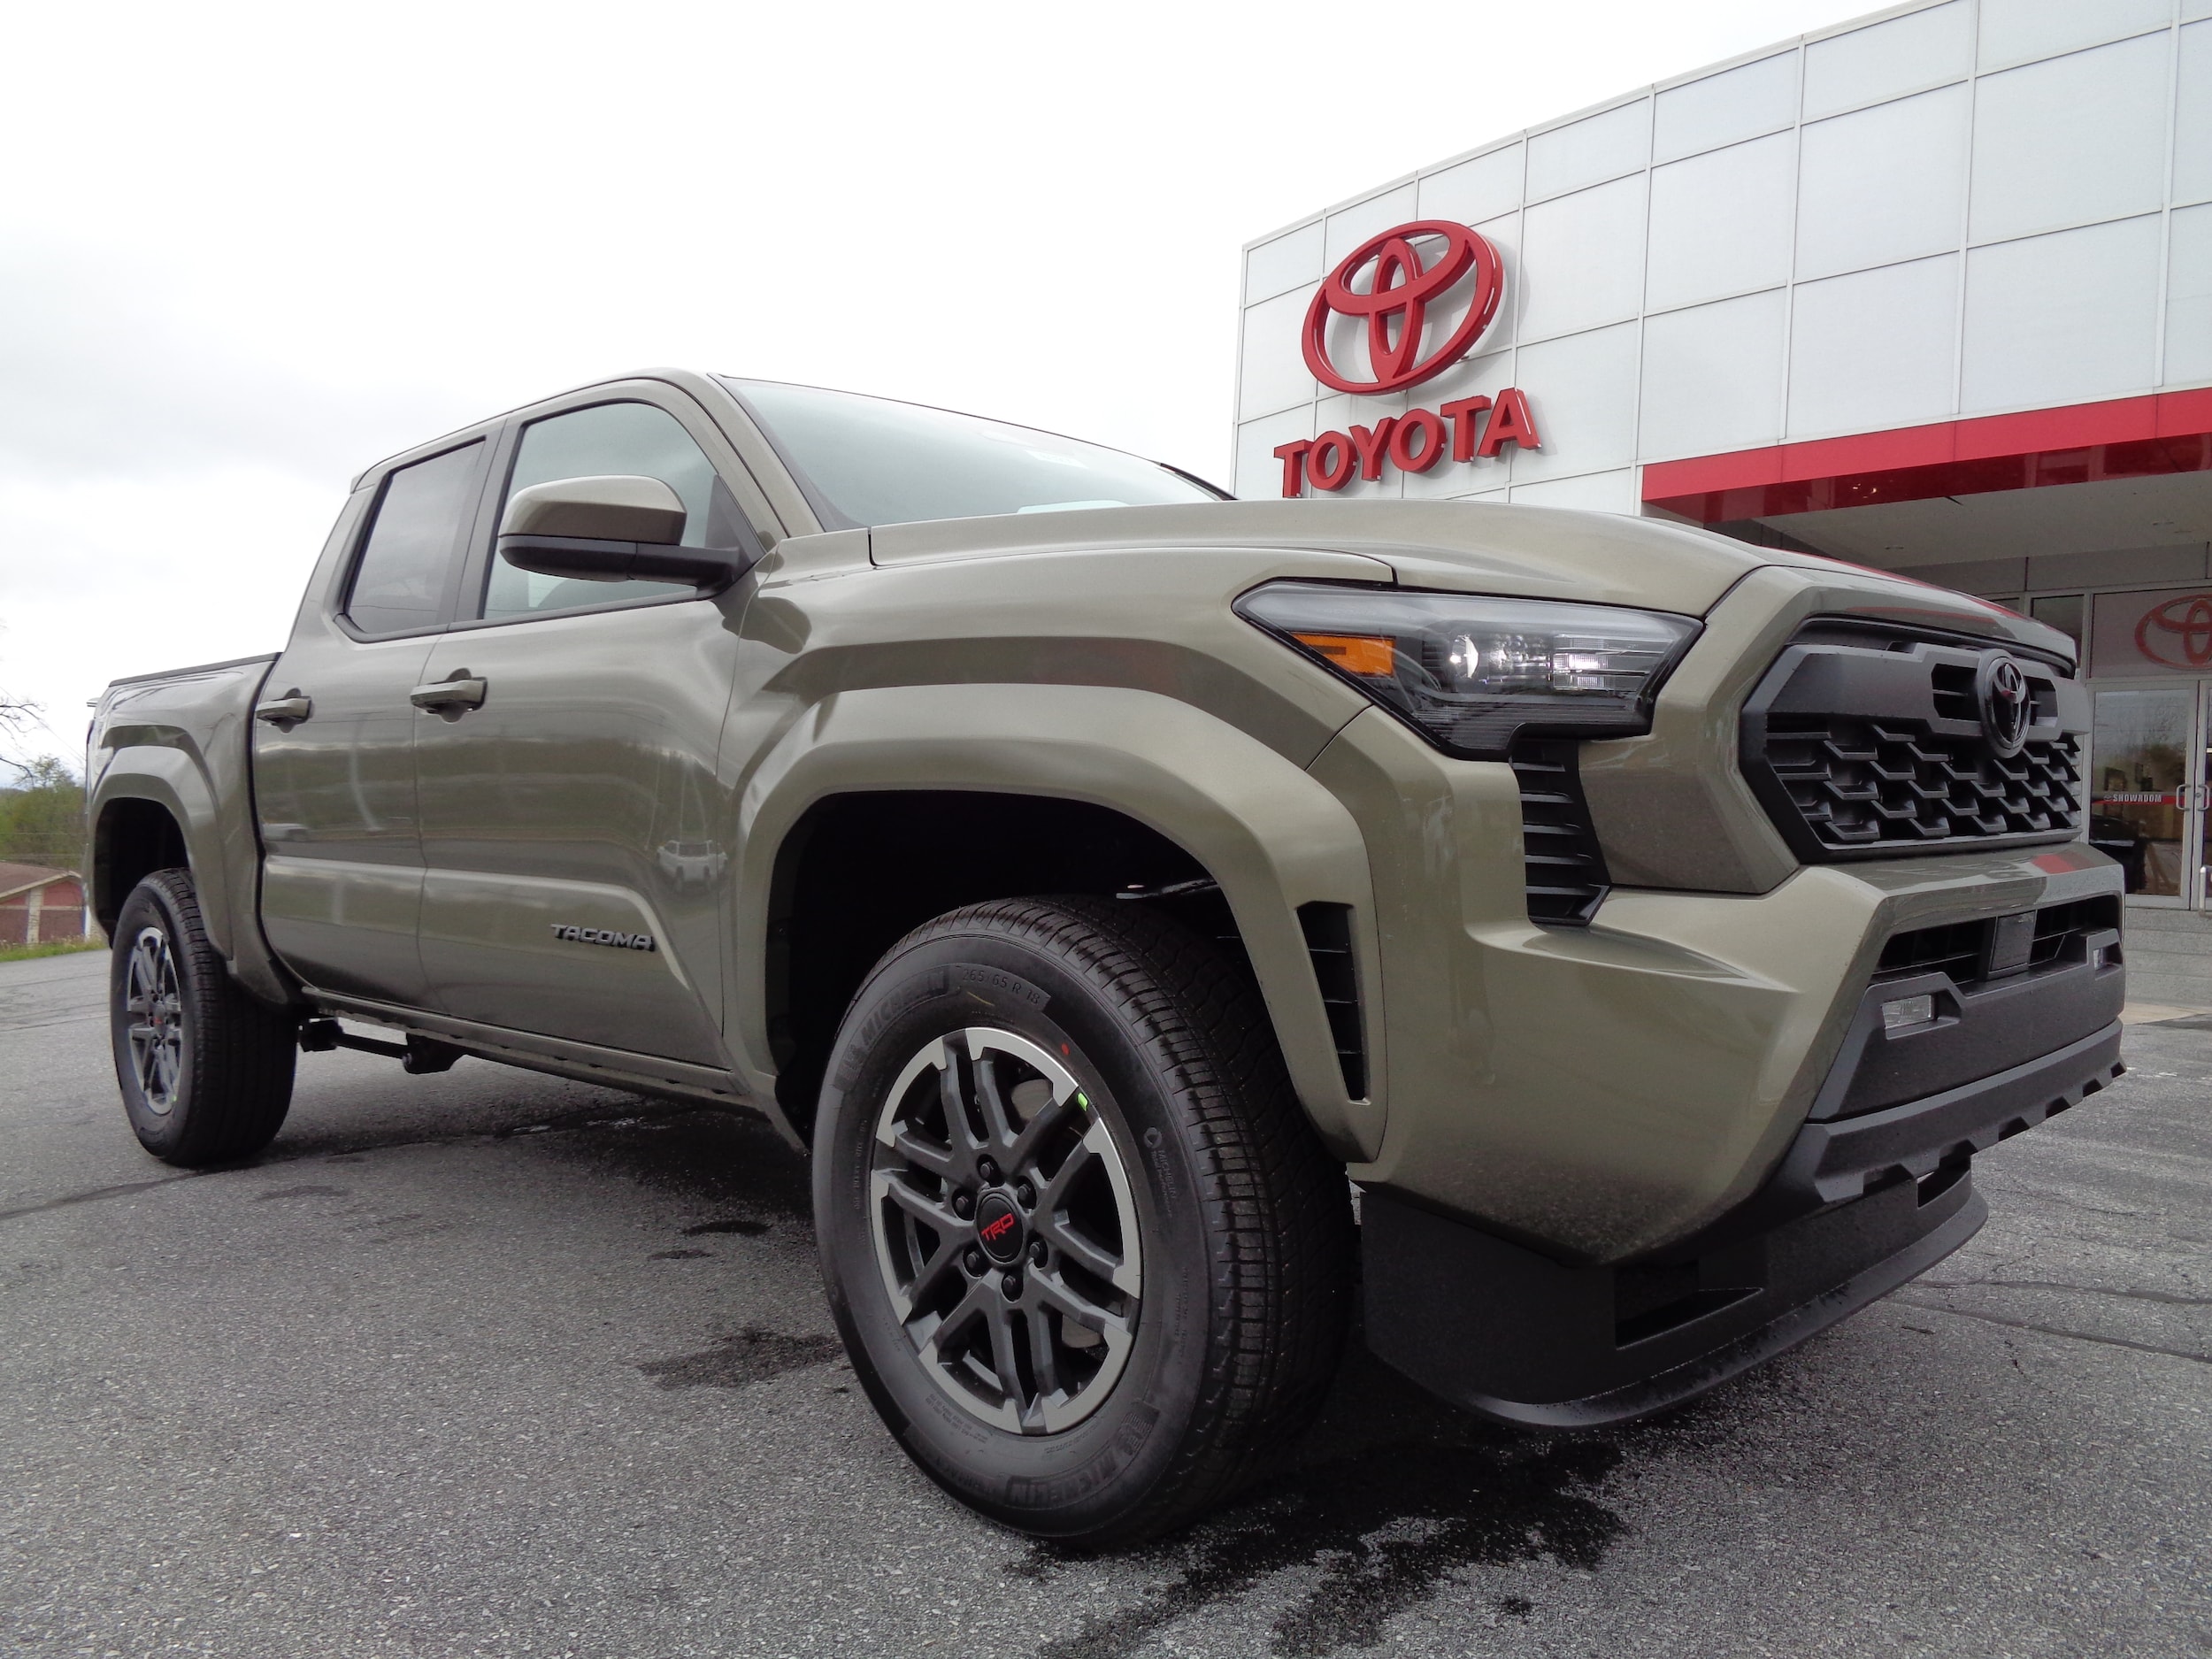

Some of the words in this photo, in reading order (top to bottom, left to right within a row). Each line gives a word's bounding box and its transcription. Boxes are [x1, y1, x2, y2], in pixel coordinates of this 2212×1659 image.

[1273, 387, 1542, 498] TOYOTA
[2112, 793, 2162, 803] SHOWROOM
[549, 923, 656, 952] TACOMA
[962, 967, 1009, 989] 265/65
[1011, 982, 1023, 995] R
[1026, 988, 1041, 1005] 18
[1156, 1148, 1179, 1200] MICHELIN
[980, 1212, 1015, 1241] TRD
